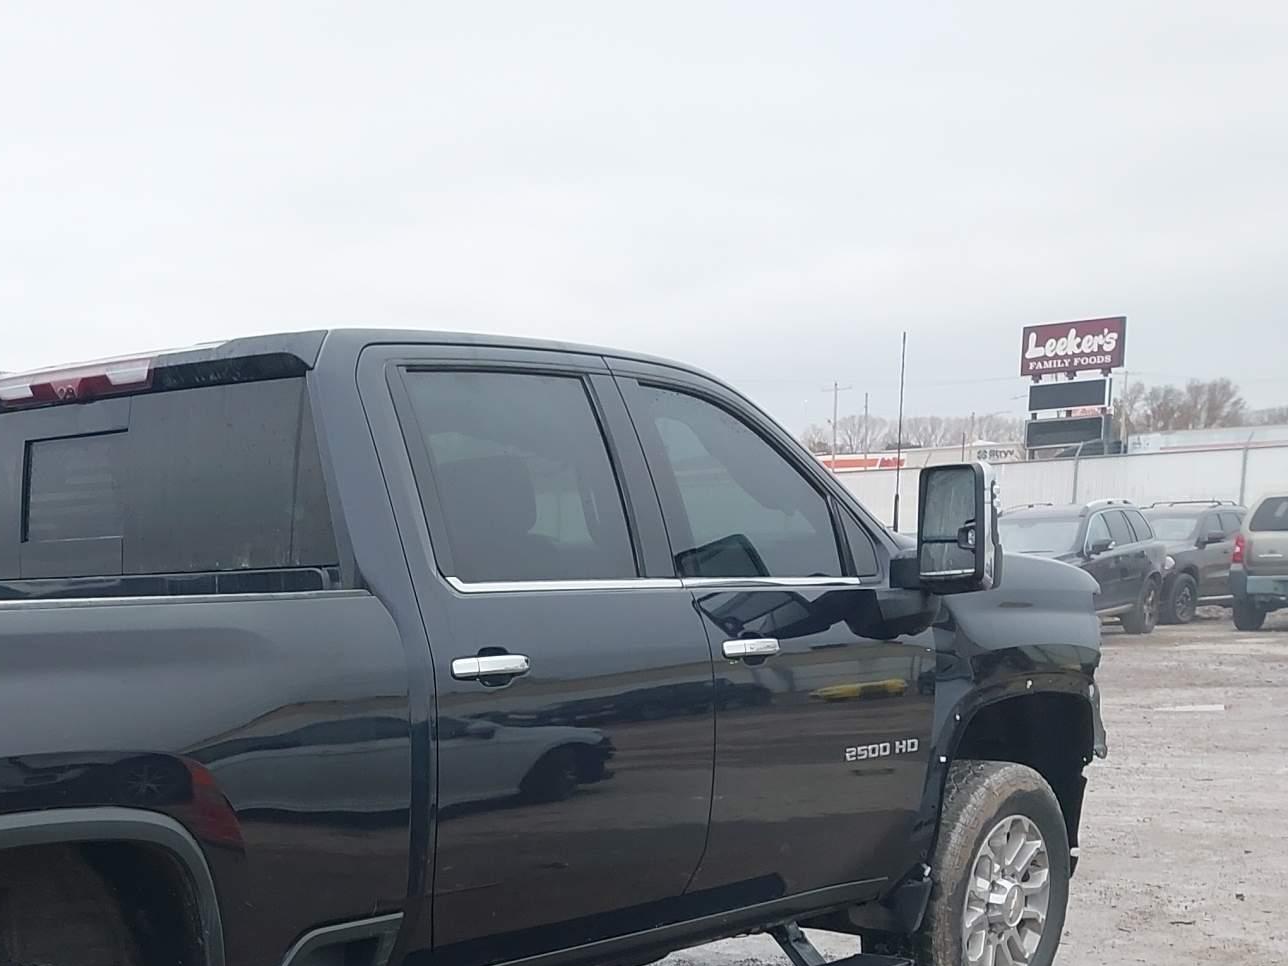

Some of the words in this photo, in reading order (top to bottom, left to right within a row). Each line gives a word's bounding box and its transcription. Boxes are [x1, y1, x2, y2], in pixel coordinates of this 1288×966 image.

[1025, 328, 1118, 359] Leeker's
[1028, 359, 1071, 371] FAMILY
[1073, 355, 1112, 367] FOODS
[845, 742, 891, 761] 2500
[894, 738, 919, 753] HD
